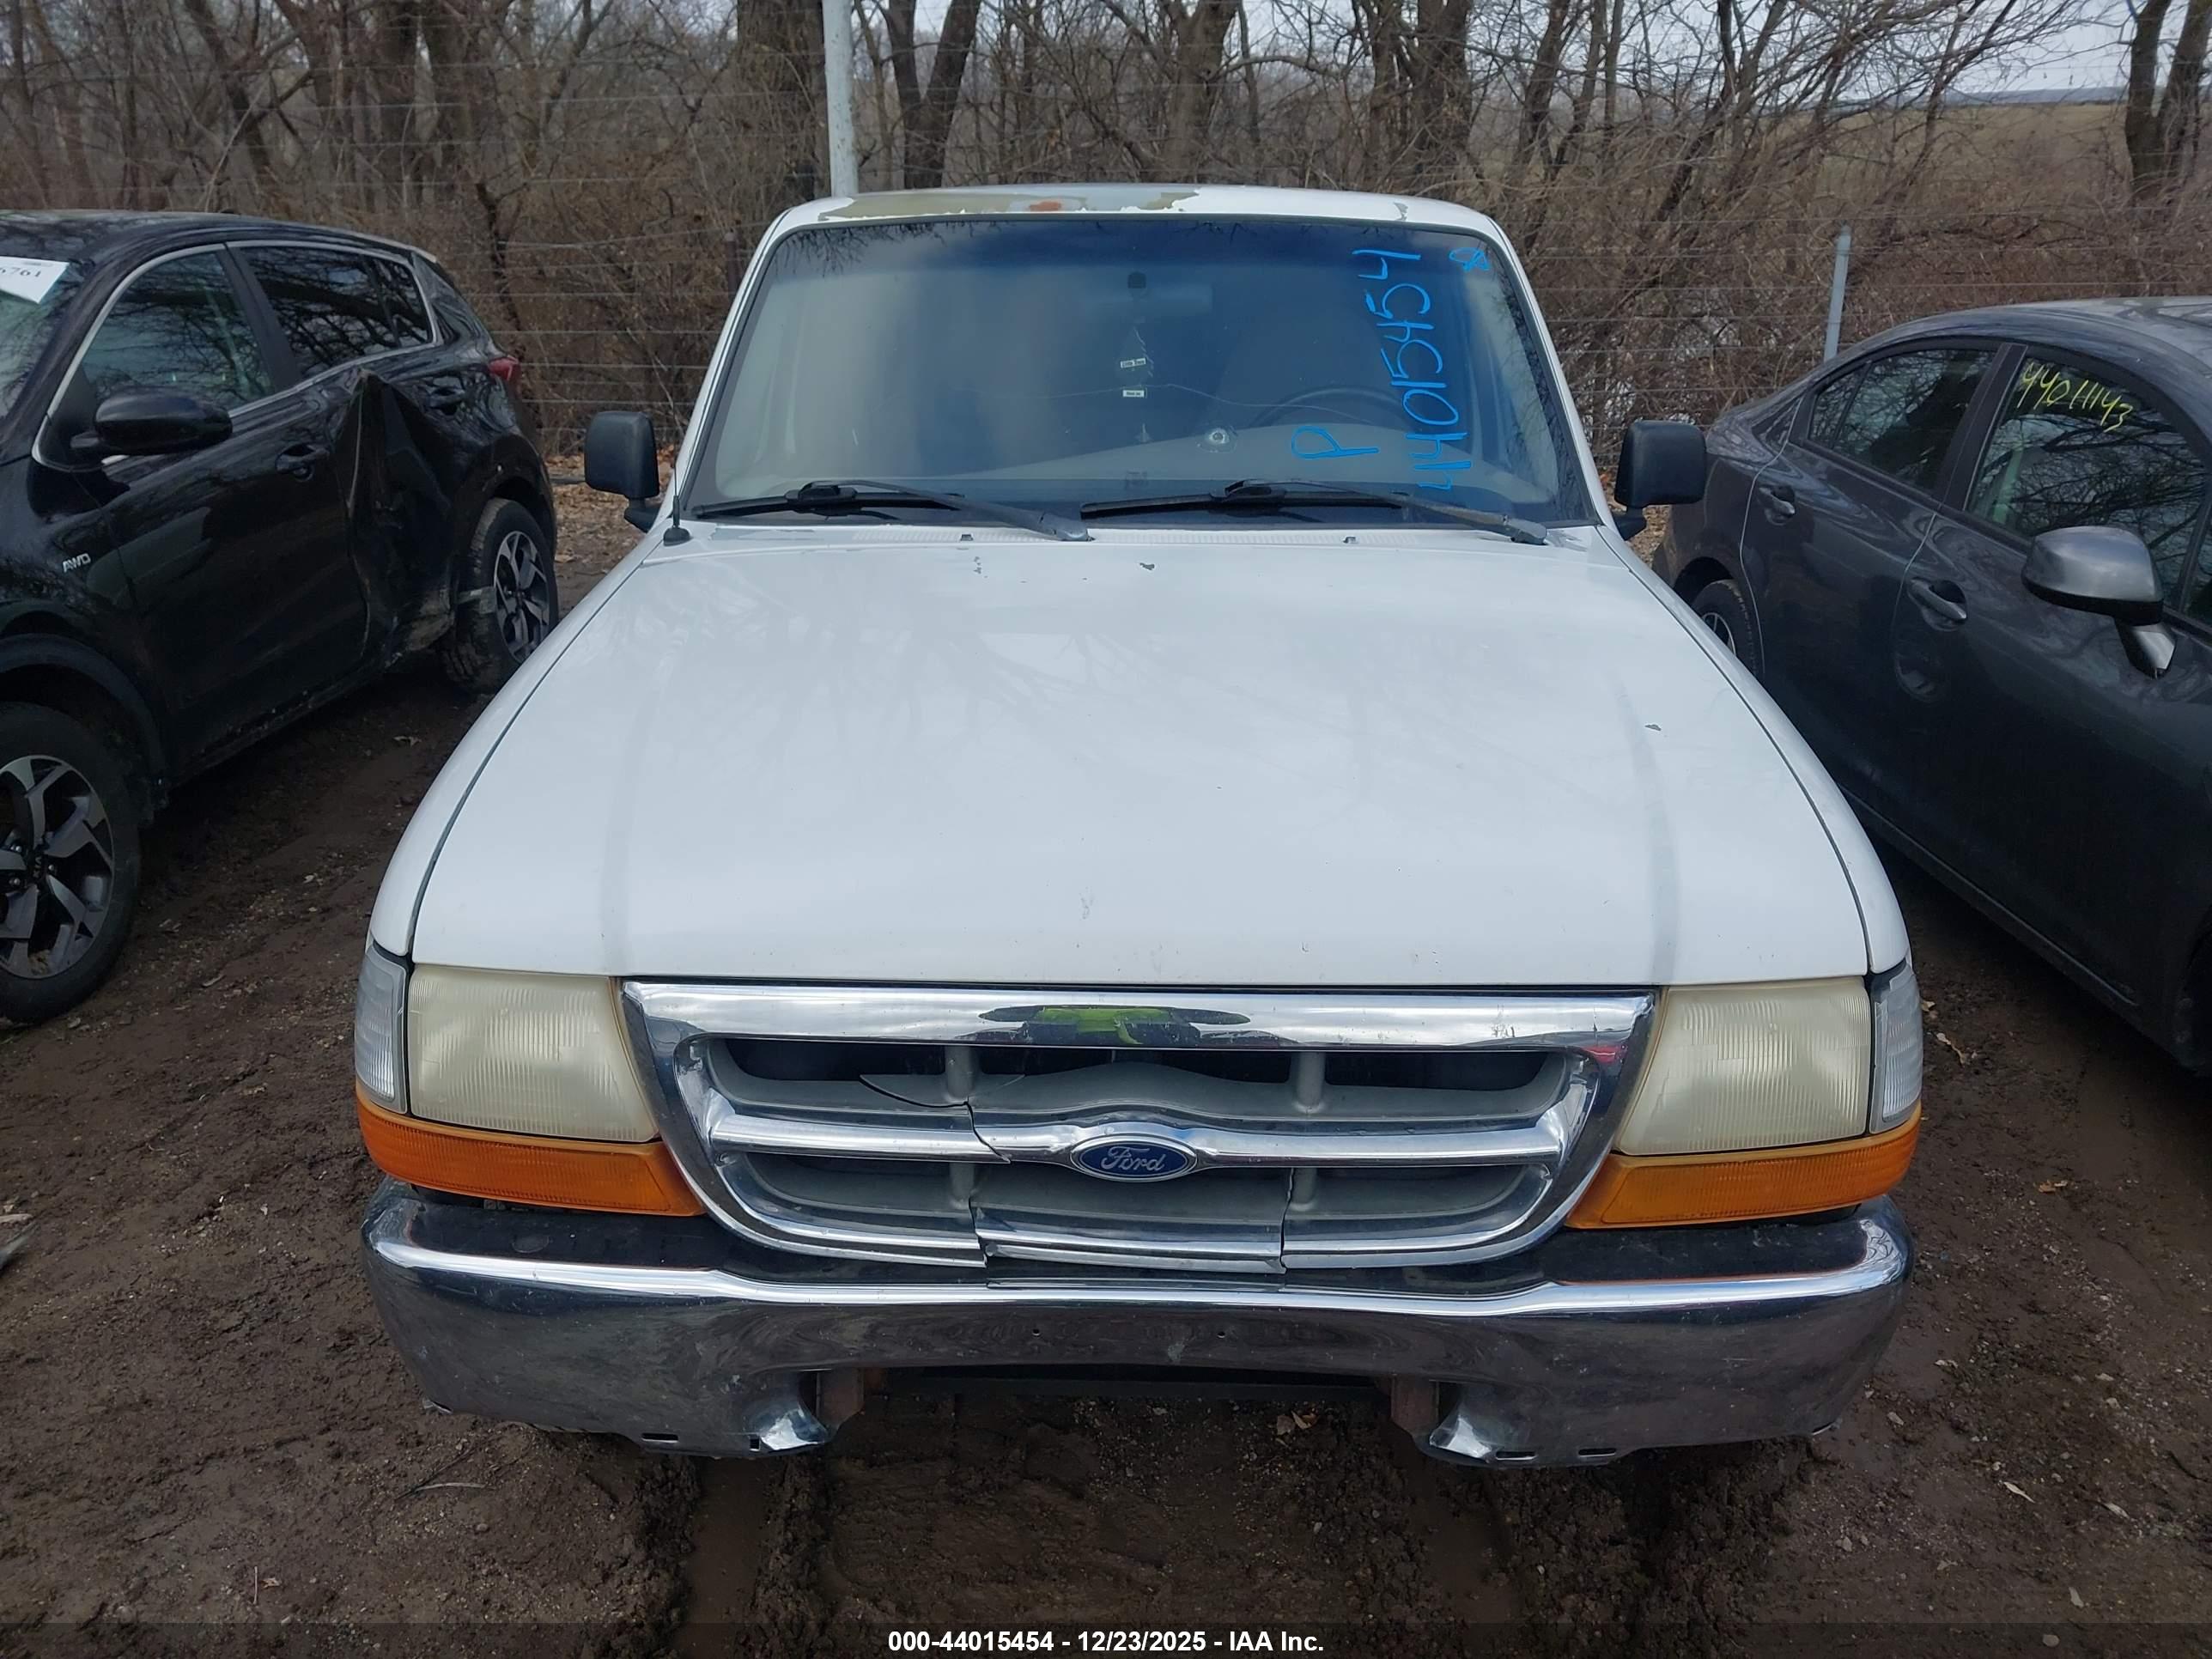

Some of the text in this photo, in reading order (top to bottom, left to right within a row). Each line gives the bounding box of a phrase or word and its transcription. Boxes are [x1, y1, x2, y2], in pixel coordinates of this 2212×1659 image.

[1352, 249, 1472, 490] 44015454
[2017, 362, 2133, 434] 44011143
[63, 552, 91, 573] AWD
[1100, 1146, 1165, 1171] Ford
